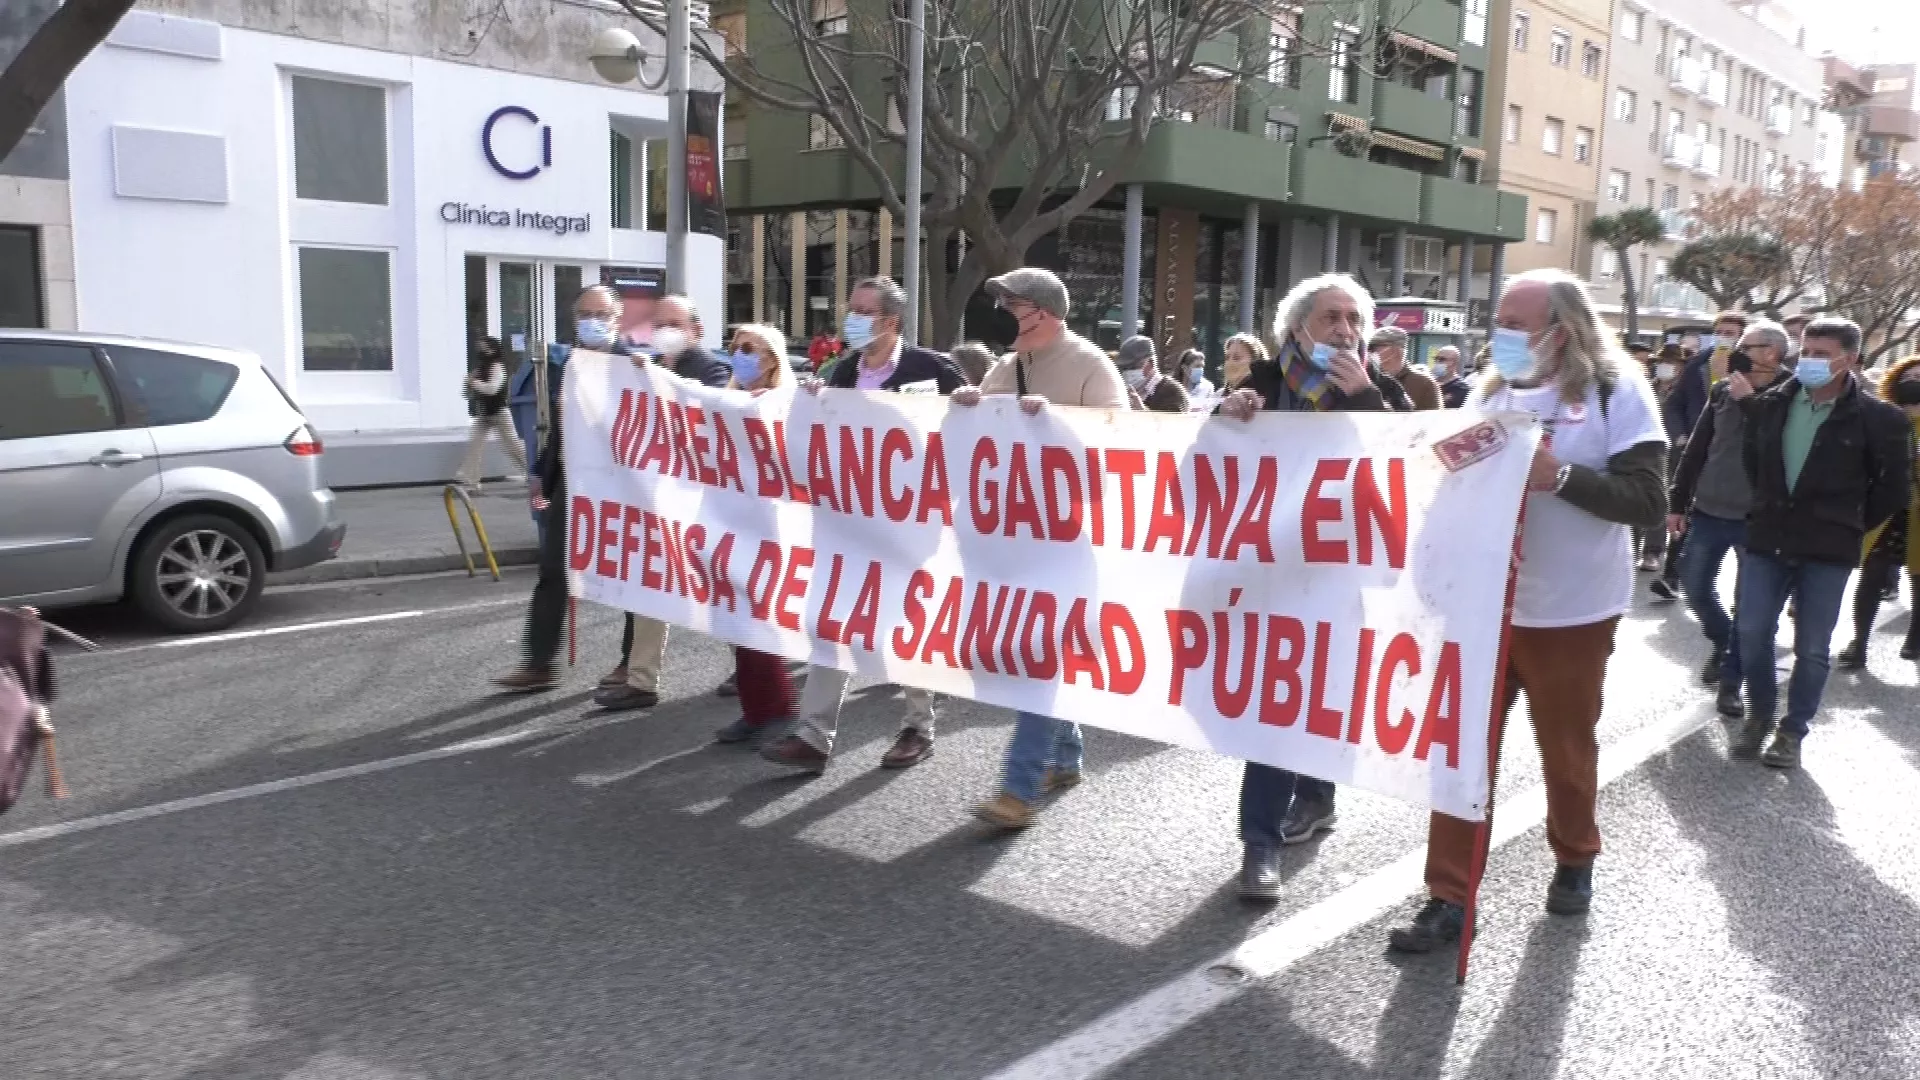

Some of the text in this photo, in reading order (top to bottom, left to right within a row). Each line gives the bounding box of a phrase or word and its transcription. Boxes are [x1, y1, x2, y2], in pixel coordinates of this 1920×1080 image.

[440, 201, 591, 235] Clínica Integral
[611, 388, 1408, 570] MAREA BLANCA GADITANA EN
[569, 495, 1462, 770] DEFENSA DE LA SANIDAD PÚBLICA
